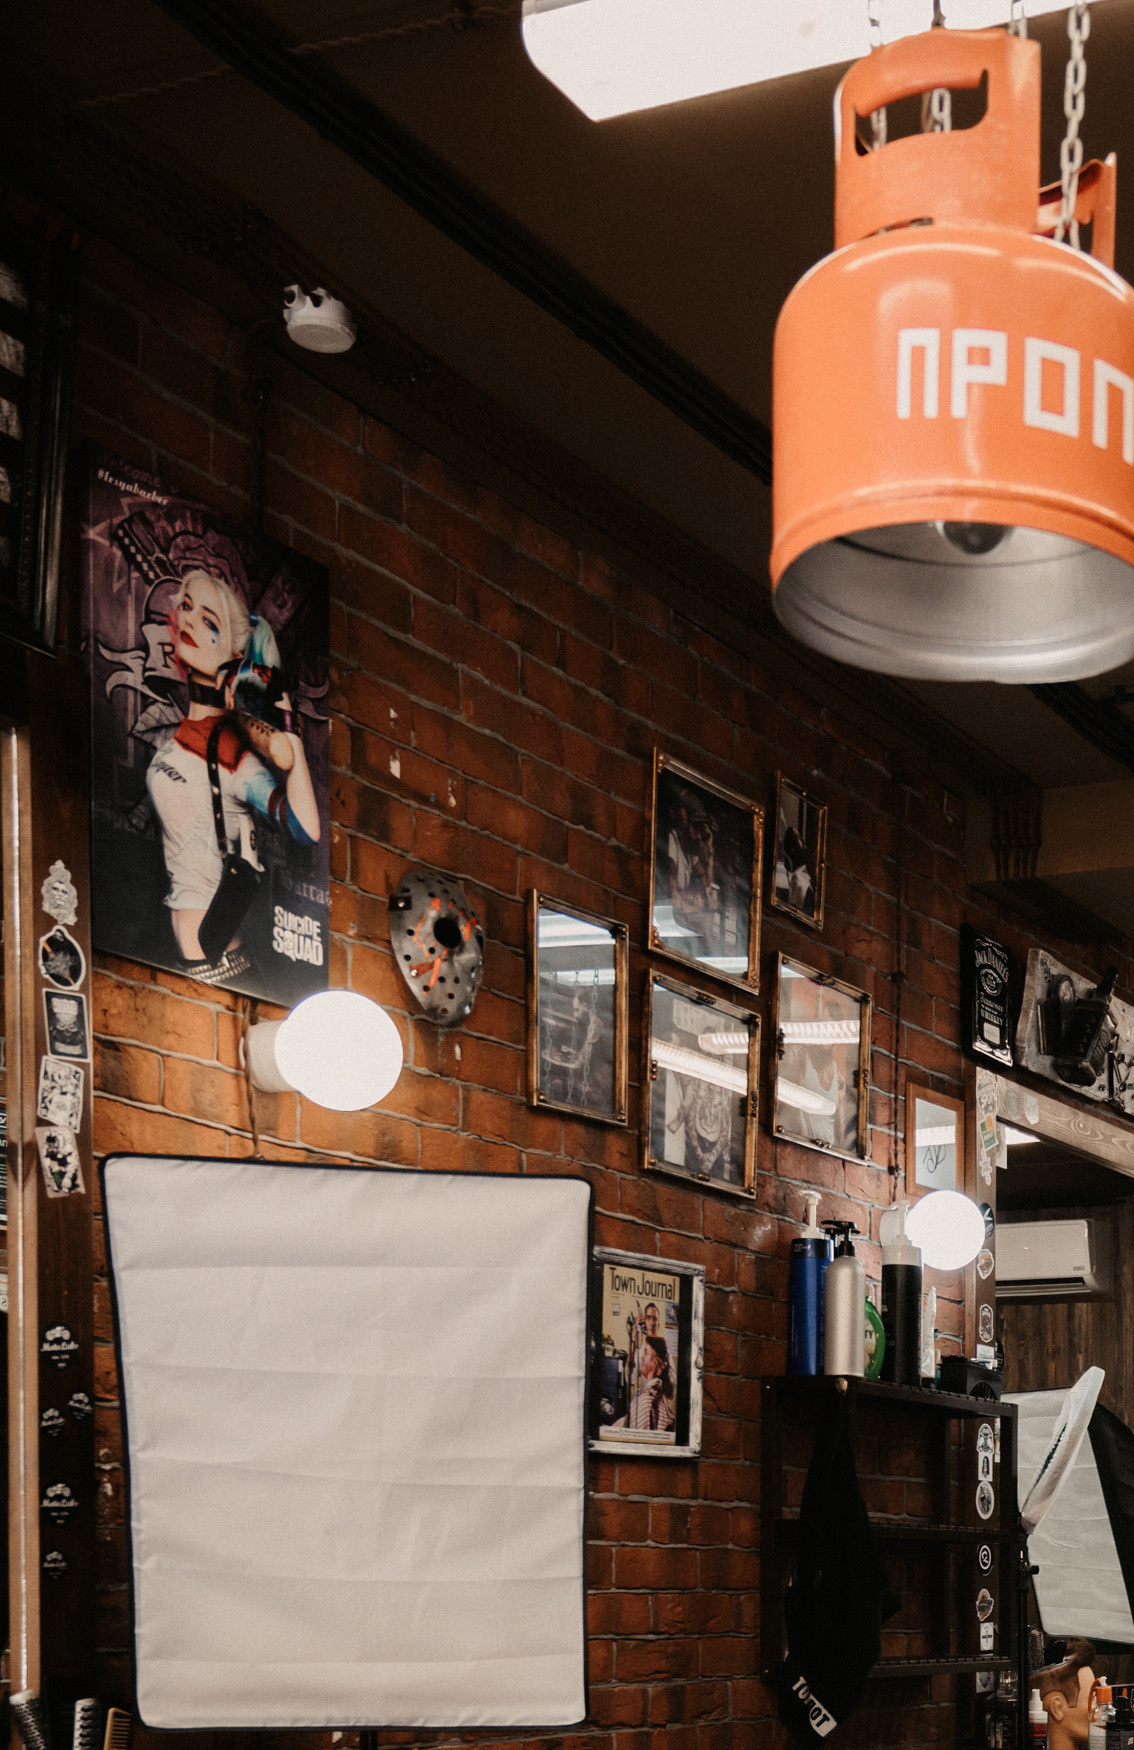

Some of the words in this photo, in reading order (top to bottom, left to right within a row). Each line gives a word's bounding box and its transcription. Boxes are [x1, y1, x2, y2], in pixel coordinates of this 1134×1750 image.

[273, 905, 322, 943] SUICIDE
[272, 926, 325, 967] SQUAD
[609, 1266, 636, 1293] Town
[637, 1272, 676, 1301] Journal
